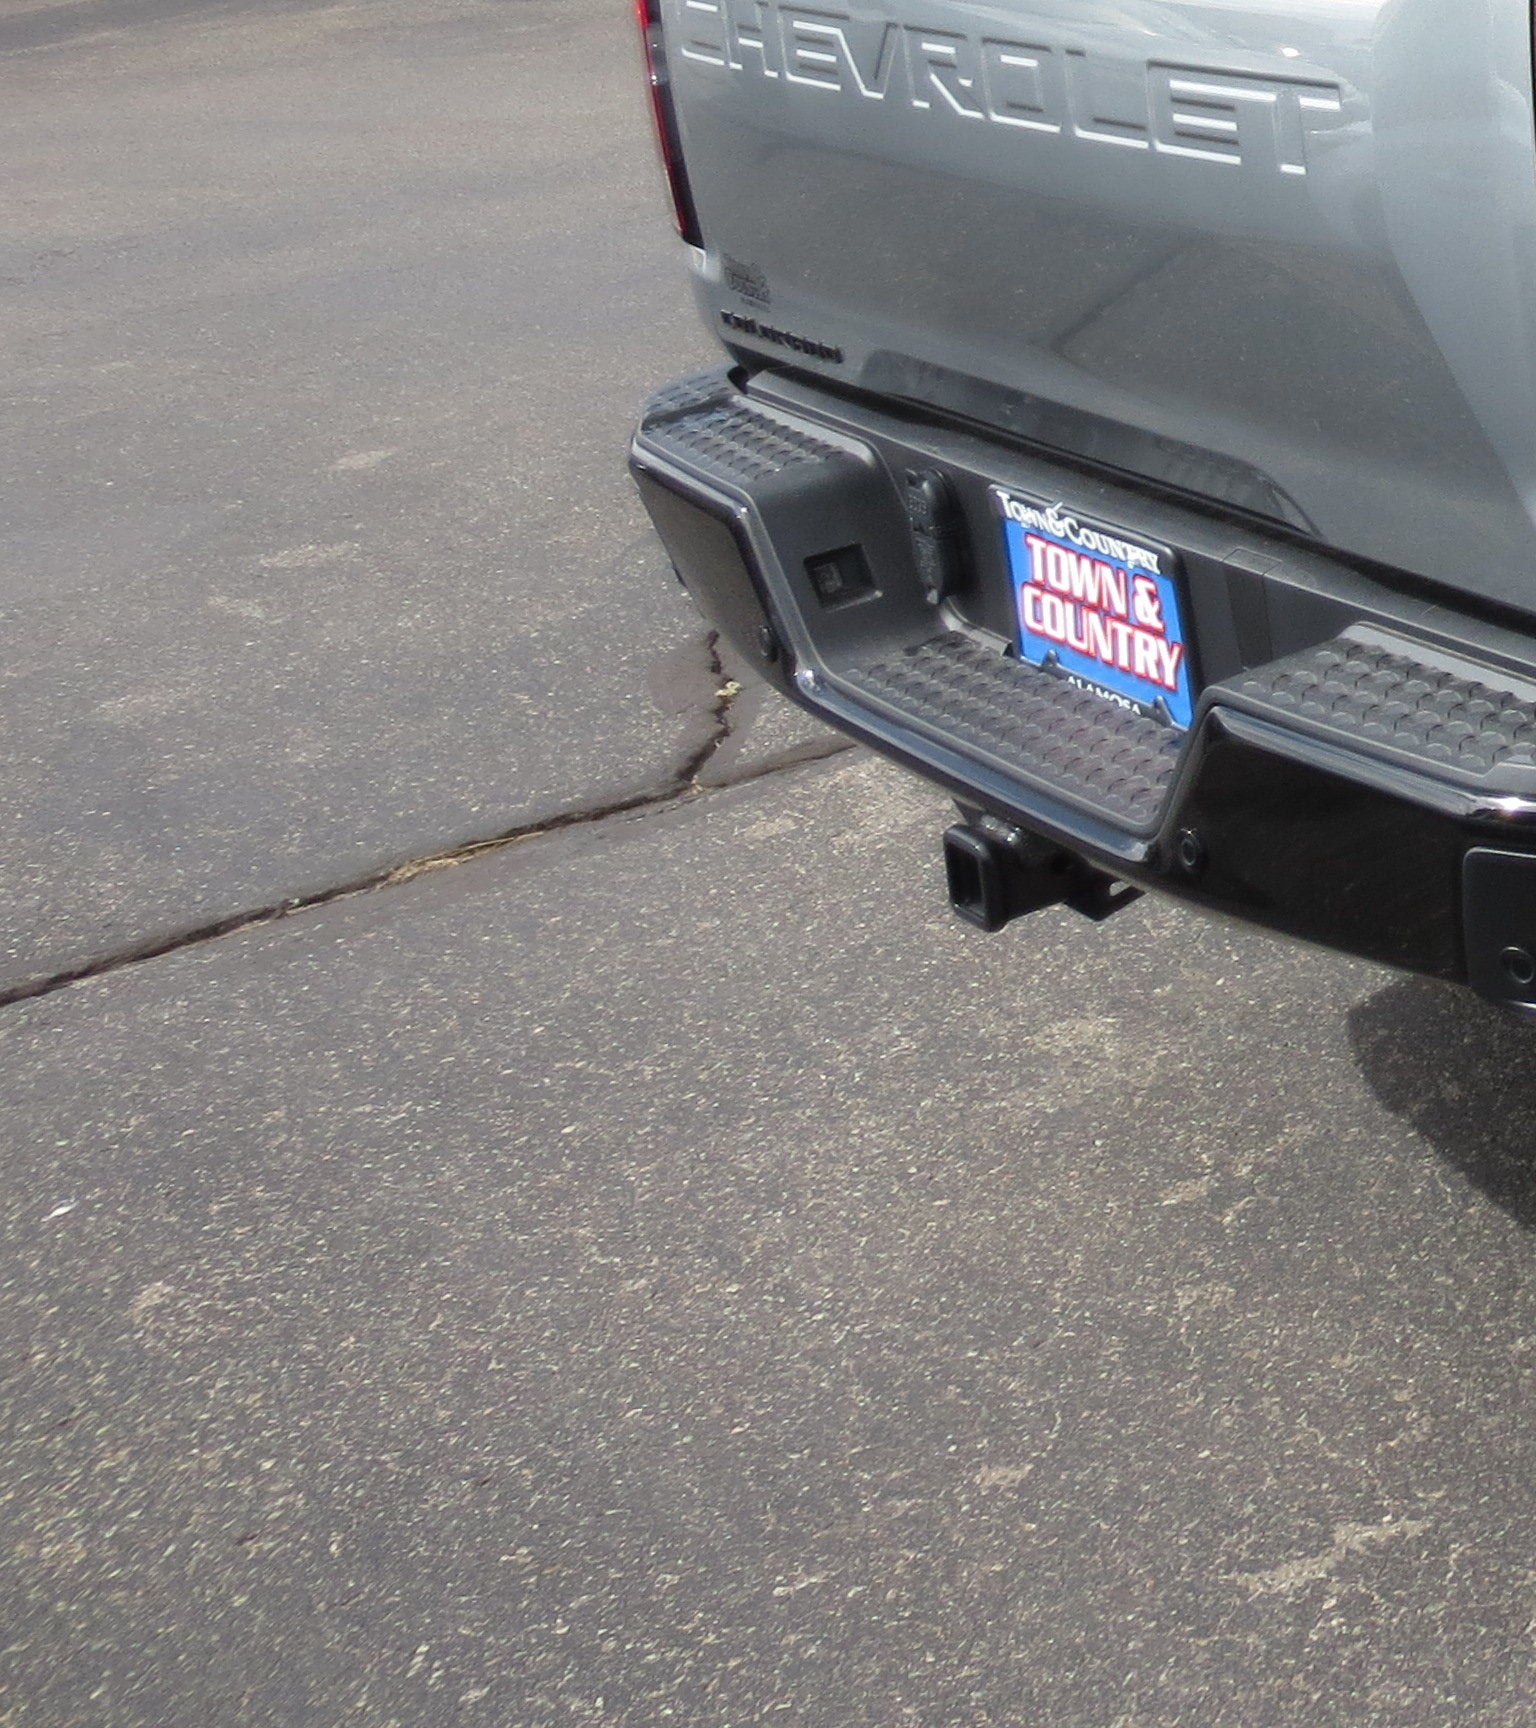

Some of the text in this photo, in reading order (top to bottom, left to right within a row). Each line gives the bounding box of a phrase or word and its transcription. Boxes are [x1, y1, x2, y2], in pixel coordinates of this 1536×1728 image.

[1024, 532, 1165, 633] TOWN &
[1021, 581, 1184, 692] COUNTRY
